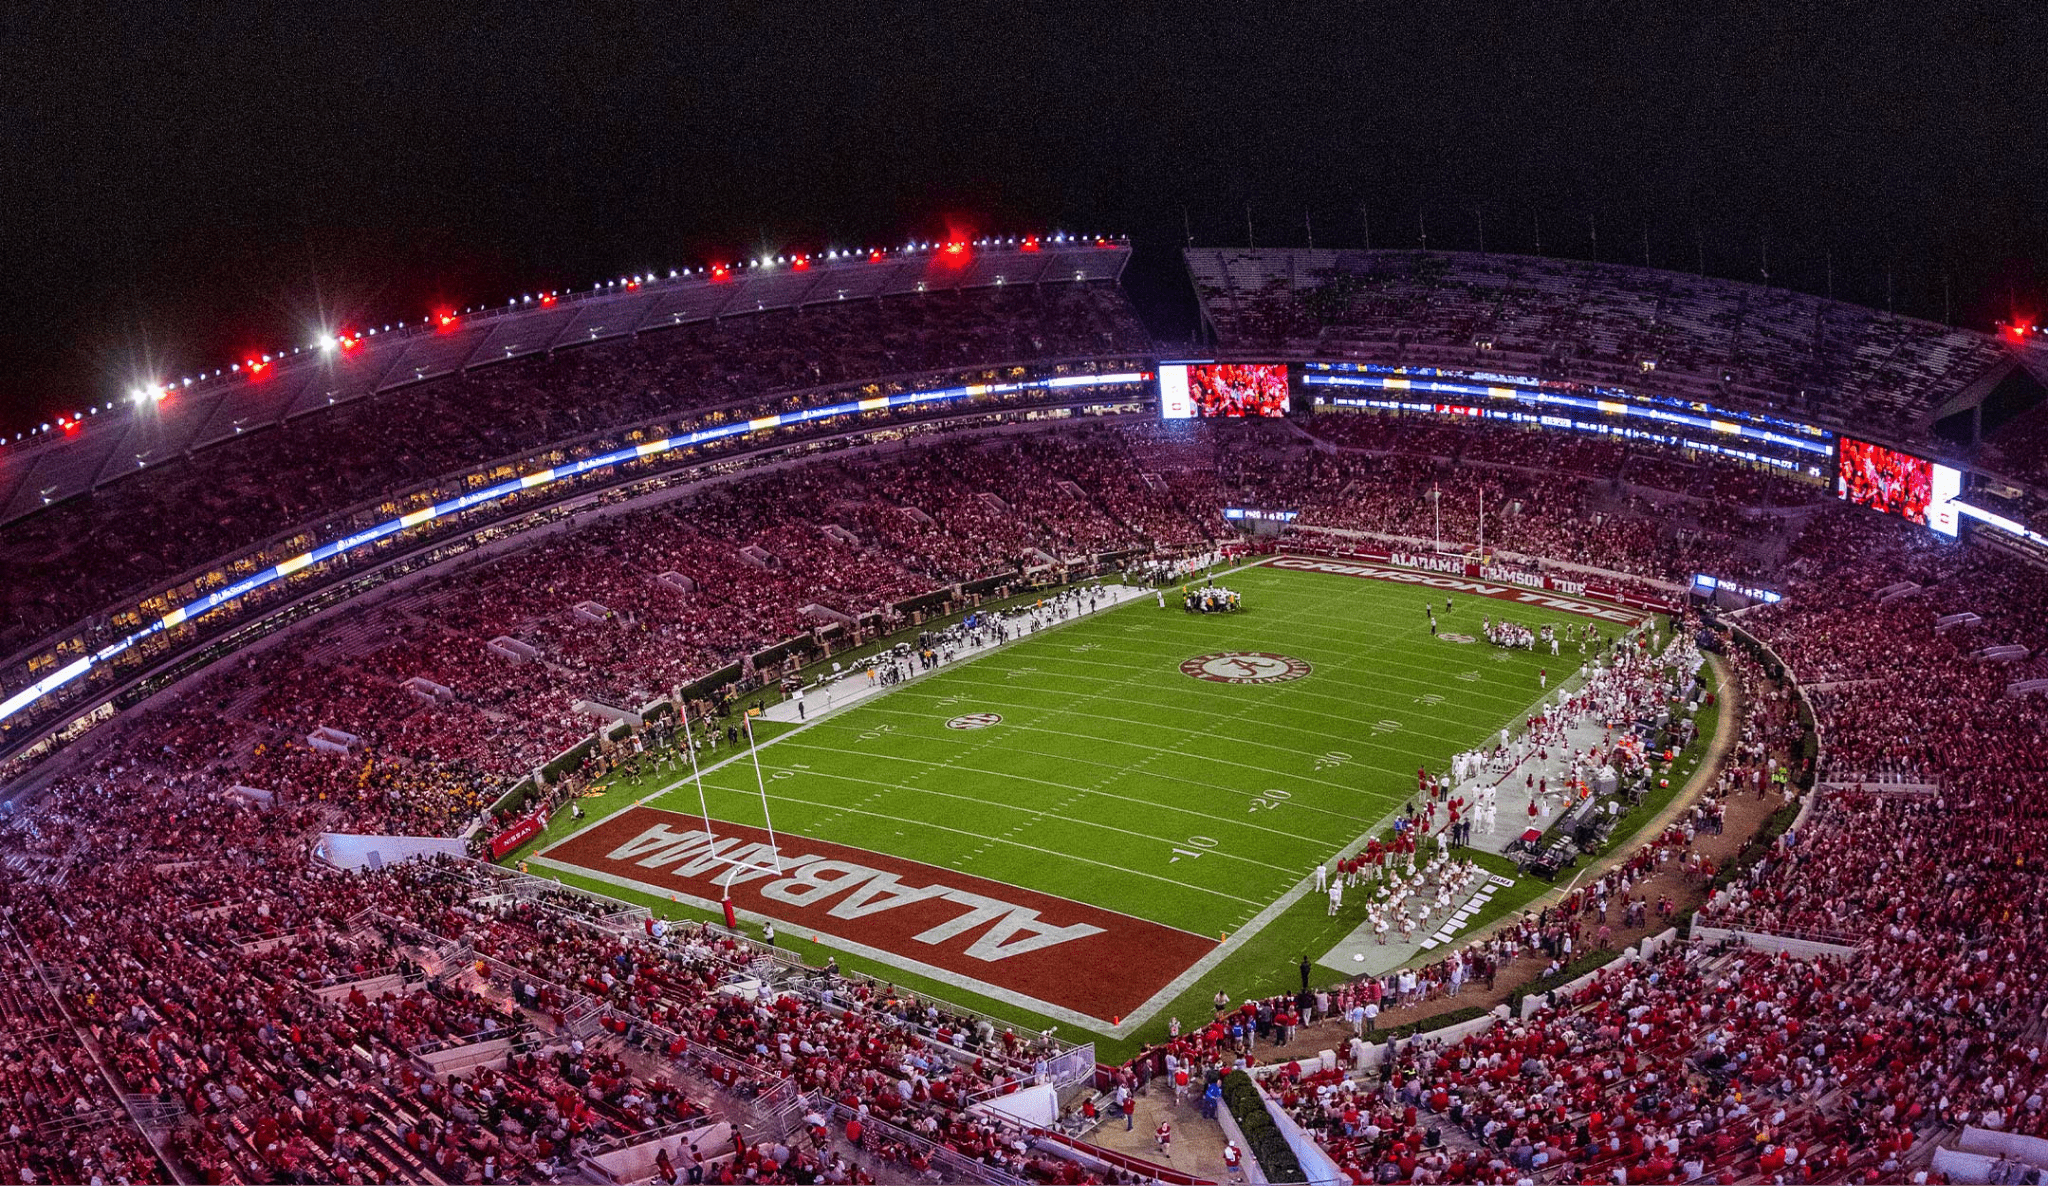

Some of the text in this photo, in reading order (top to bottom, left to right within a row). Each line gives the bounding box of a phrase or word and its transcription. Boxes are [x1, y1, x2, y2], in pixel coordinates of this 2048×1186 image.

[1273, 560, 1640, 622] CRIMSON TIDE
[1552, 578, 1586, 597] TIDE
[1250, 789, 1292, 810] 20
[503, 826, 531, 847] NISSAN
[1172, 836, 1219, 860] 10
[606, 823, 1108, 962] ALABAMA
